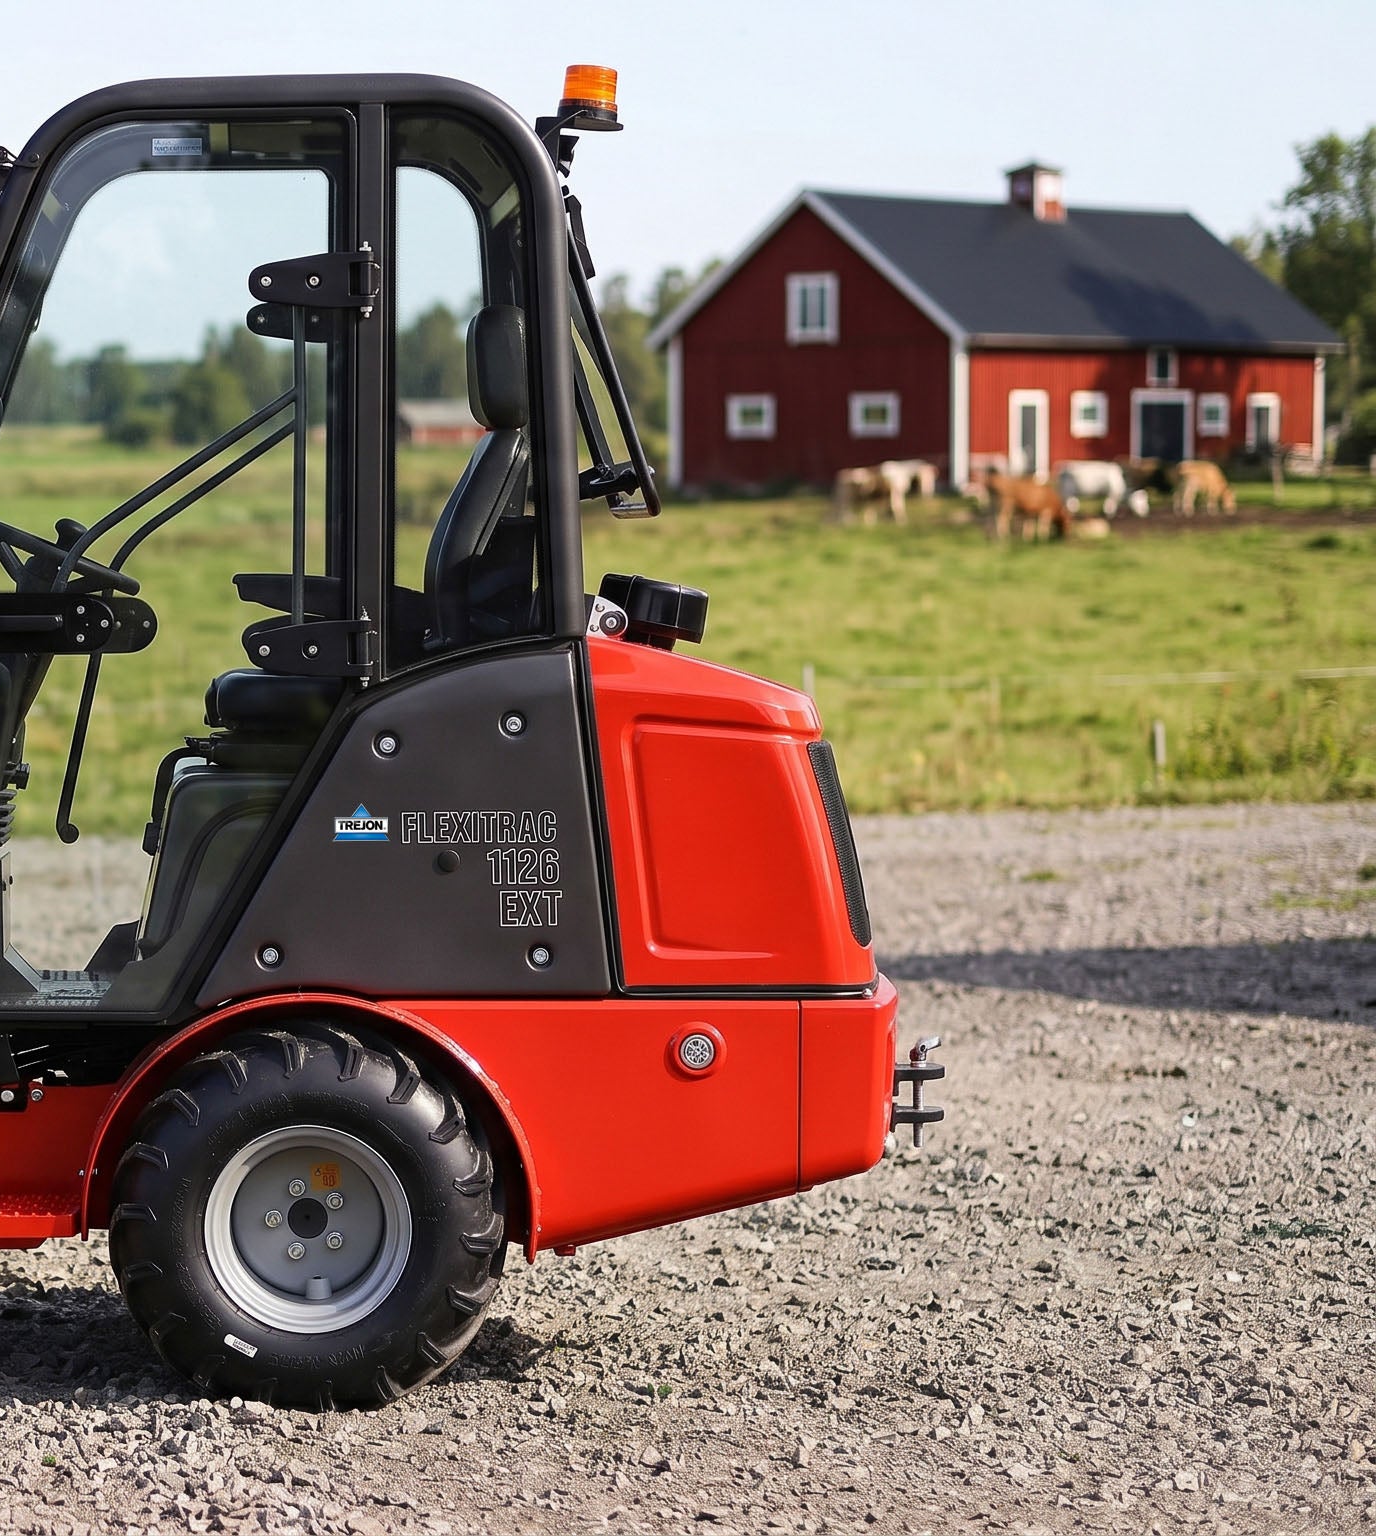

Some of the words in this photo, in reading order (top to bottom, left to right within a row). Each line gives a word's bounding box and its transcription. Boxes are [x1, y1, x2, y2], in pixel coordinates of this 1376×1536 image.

[337, 820, 384, 831] TREJON
[401, 810, 557, 844] FLEXITRAC
[486, 848, 561, 885] 1126
[499, 889, 563, 927] EXT
